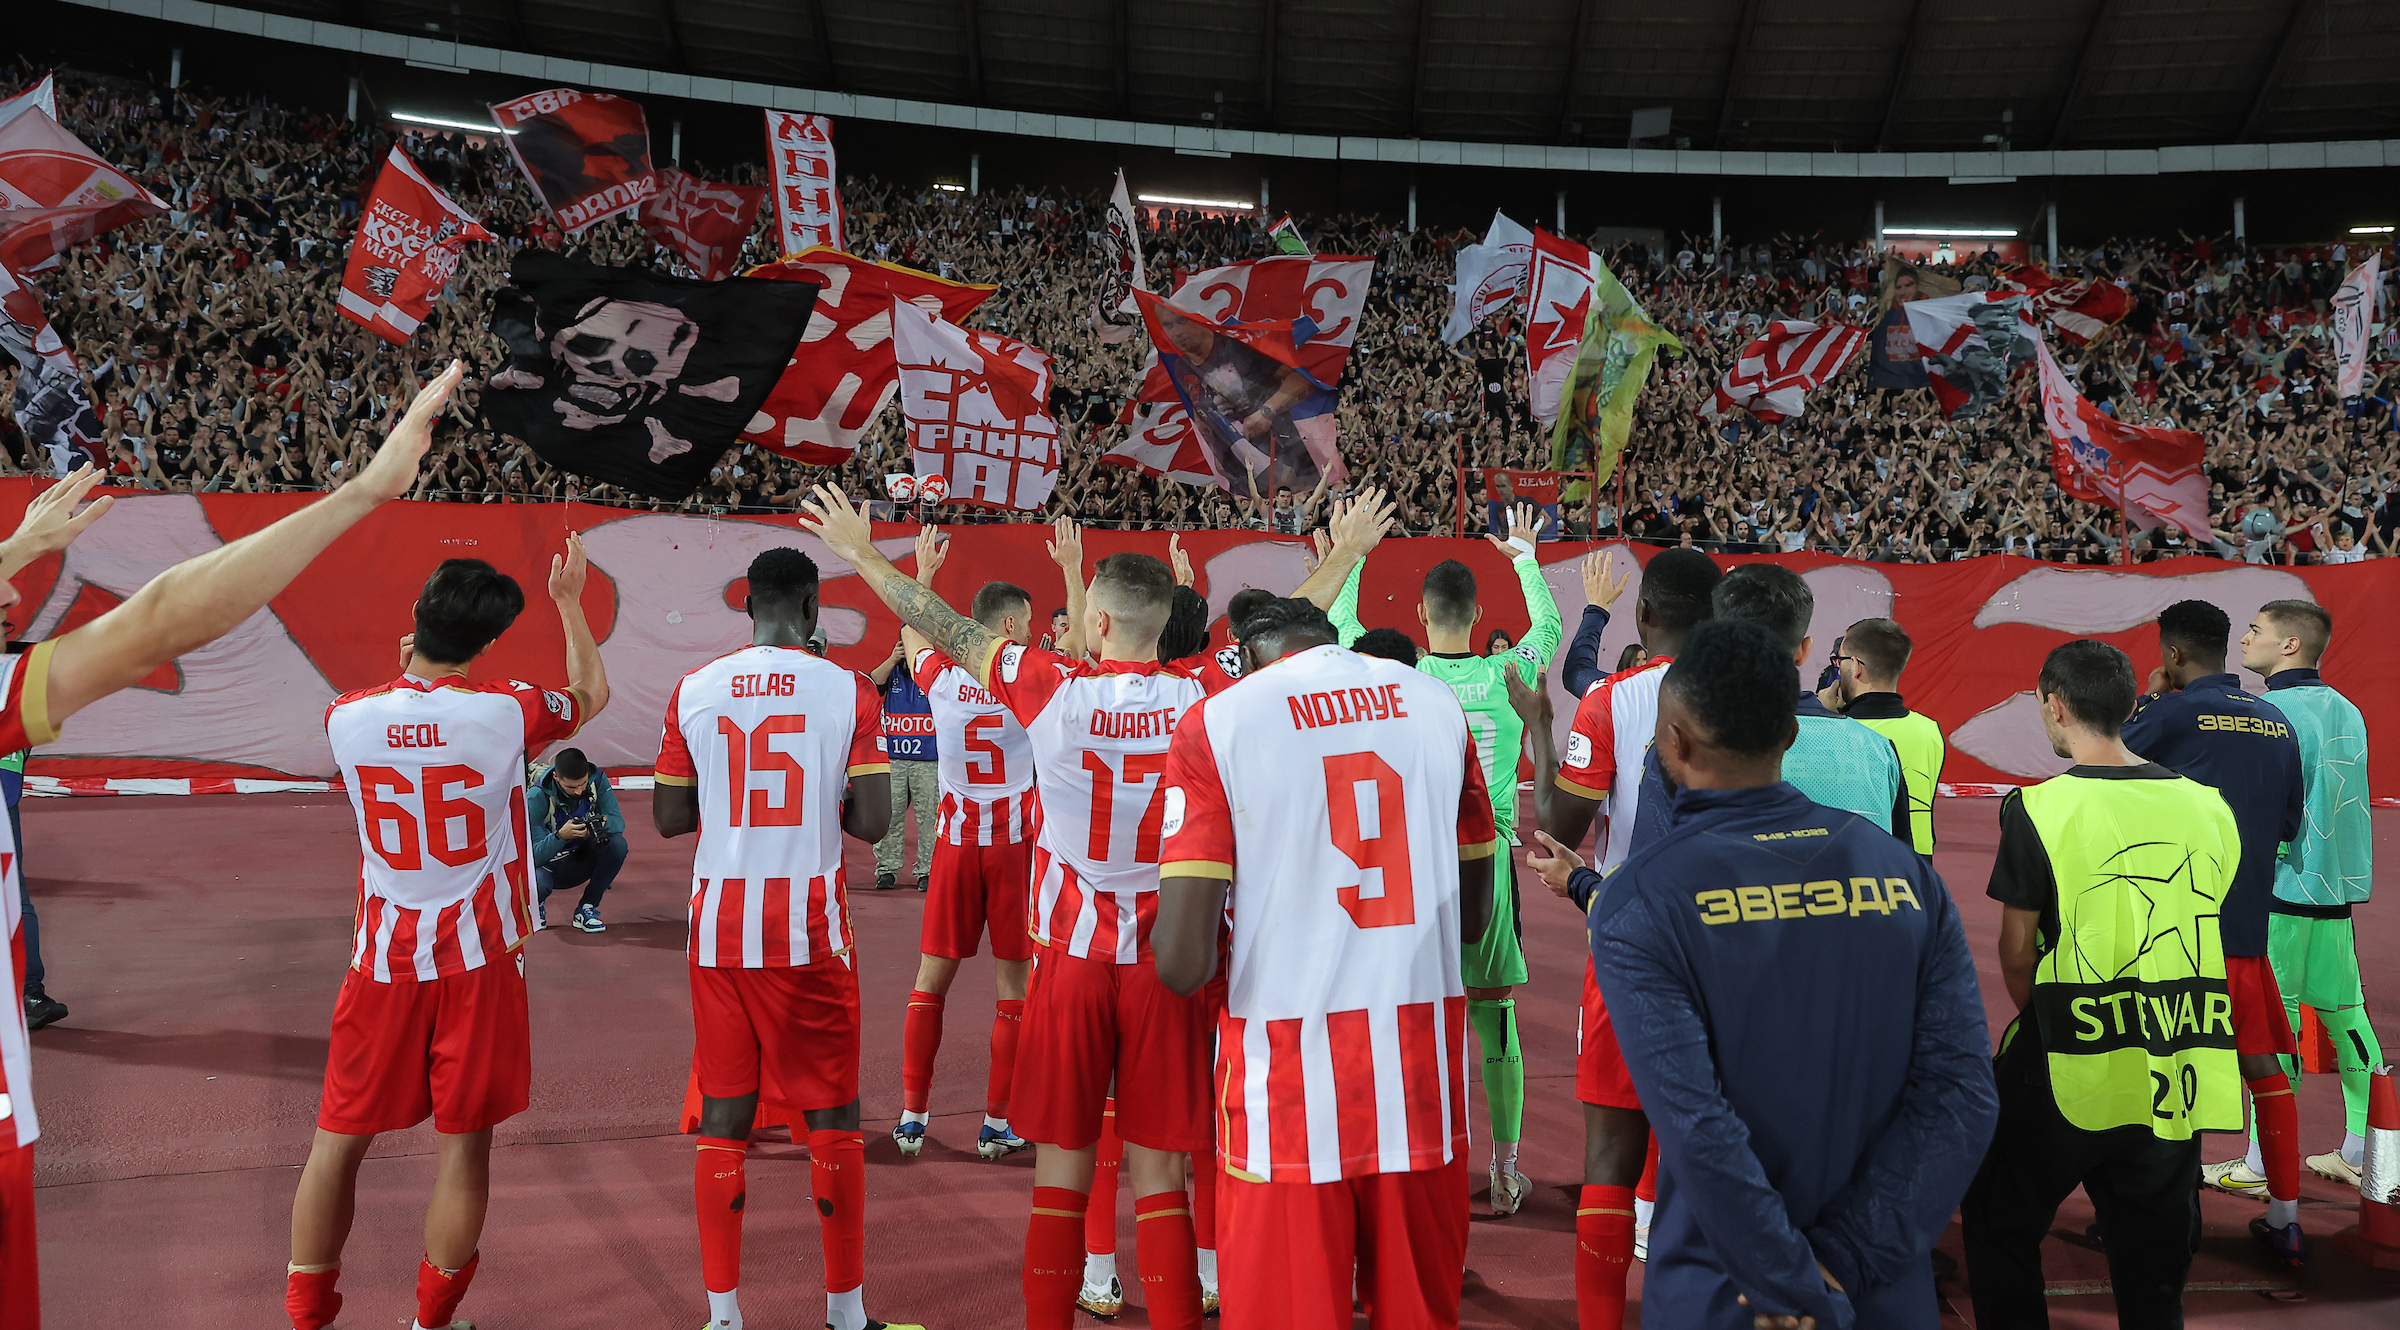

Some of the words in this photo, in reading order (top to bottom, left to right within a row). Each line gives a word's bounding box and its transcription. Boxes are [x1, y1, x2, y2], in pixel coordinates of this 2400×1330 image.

[731, 673, 796, 698] SILAS
[1287, 683, 1409, 730] NDIAYE
[387, 723, 447, 748] SEOL
[885, 716, 936, 733] PHOTO
[893, 738, 922, 755] 102
[1089, 707, 1176, 739] DUARTE
[2197, 714, 2290, 739] ЗВЕЗДА
[718, 714, 806, 827] 15
[965, 715, 1006, 783] 5
[355, 764, 488, 871] 66
[1082, 750, 1169, 864] 17
[1323, 751, 1415, 929] 9
[1695, 877, 1922, 926] ЗВЕЗДА
[2150, 1063, 2197, 1119] 20
